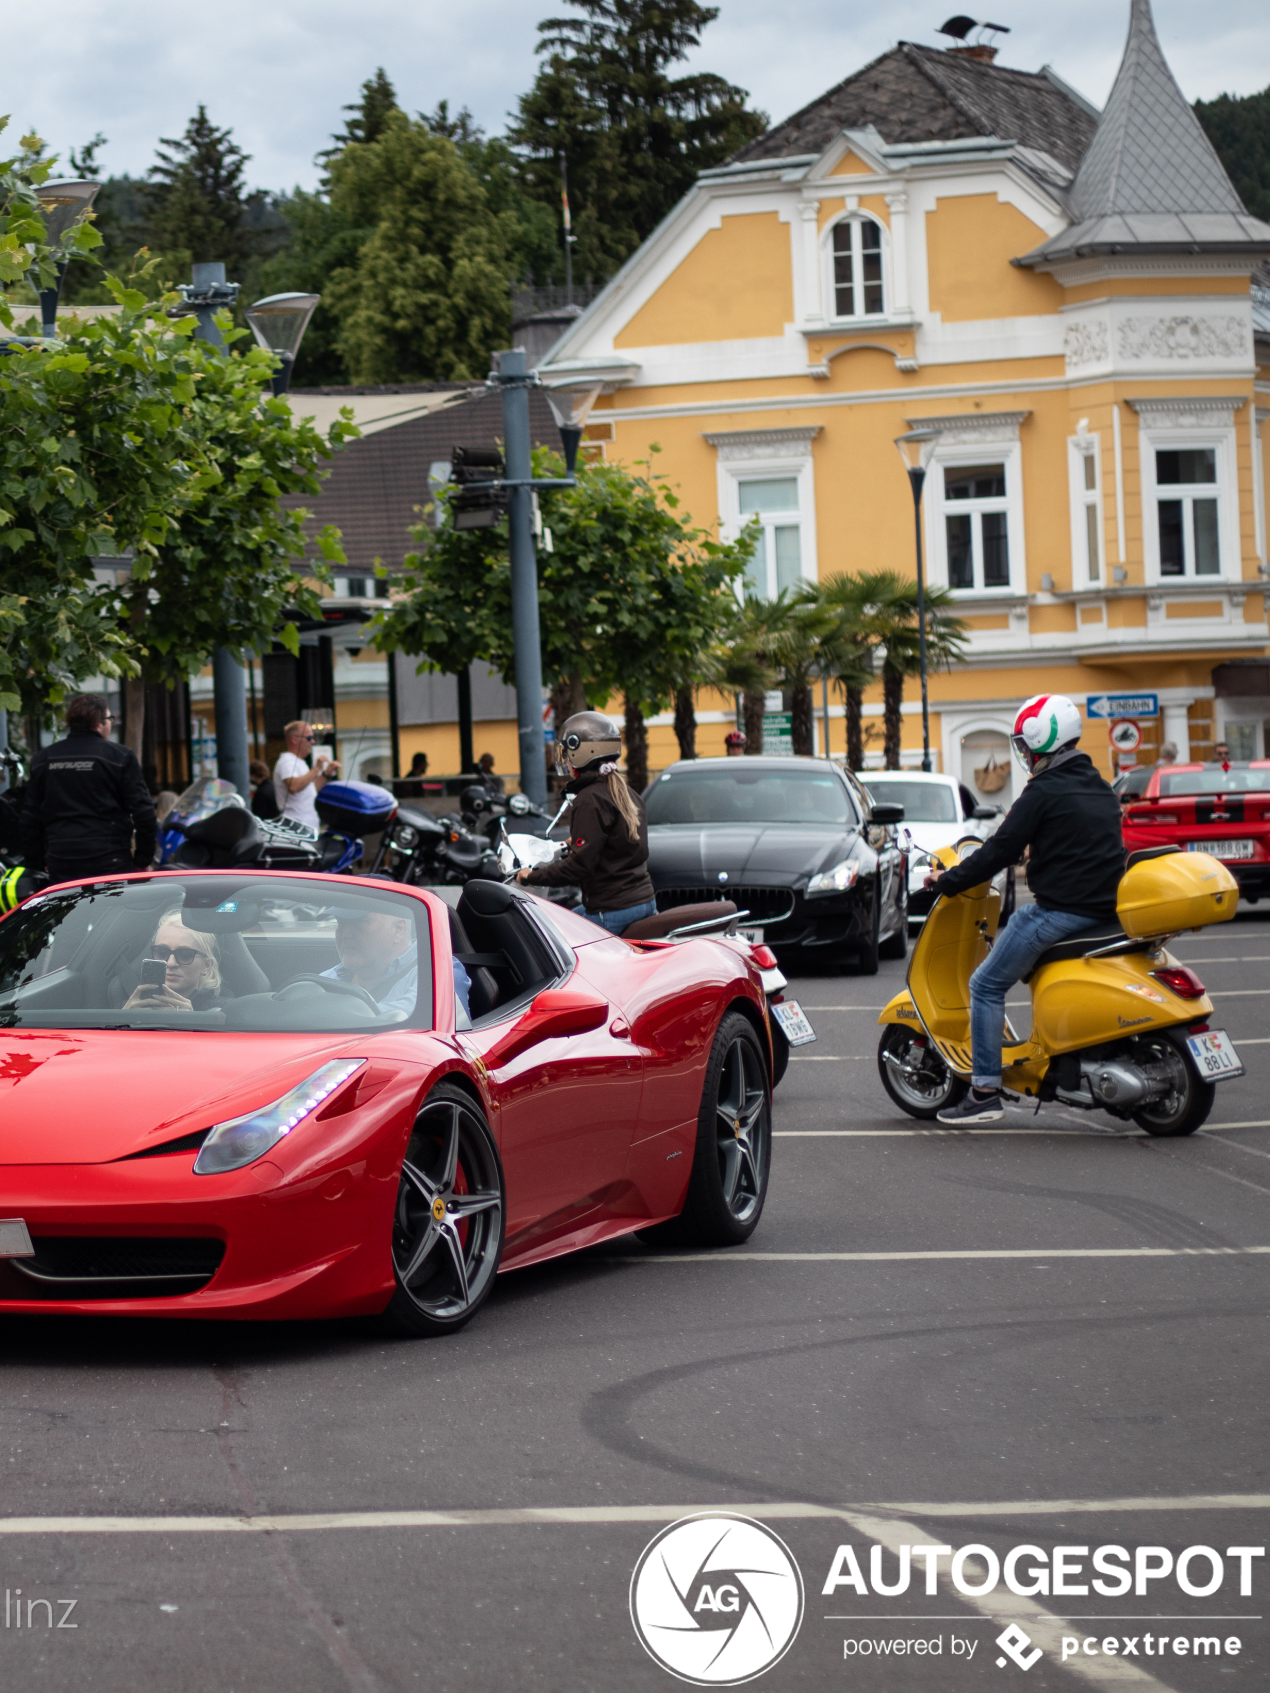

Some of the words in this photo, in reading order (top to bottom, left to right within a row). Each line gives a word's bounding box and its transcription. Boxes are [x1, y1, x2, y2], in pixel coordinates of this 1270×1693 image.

[1110, 700, 1150, 711] EINBAHN
[1201, 1038, 1212, 1053] K
[1204, 1055, 1221, 1071] 88
